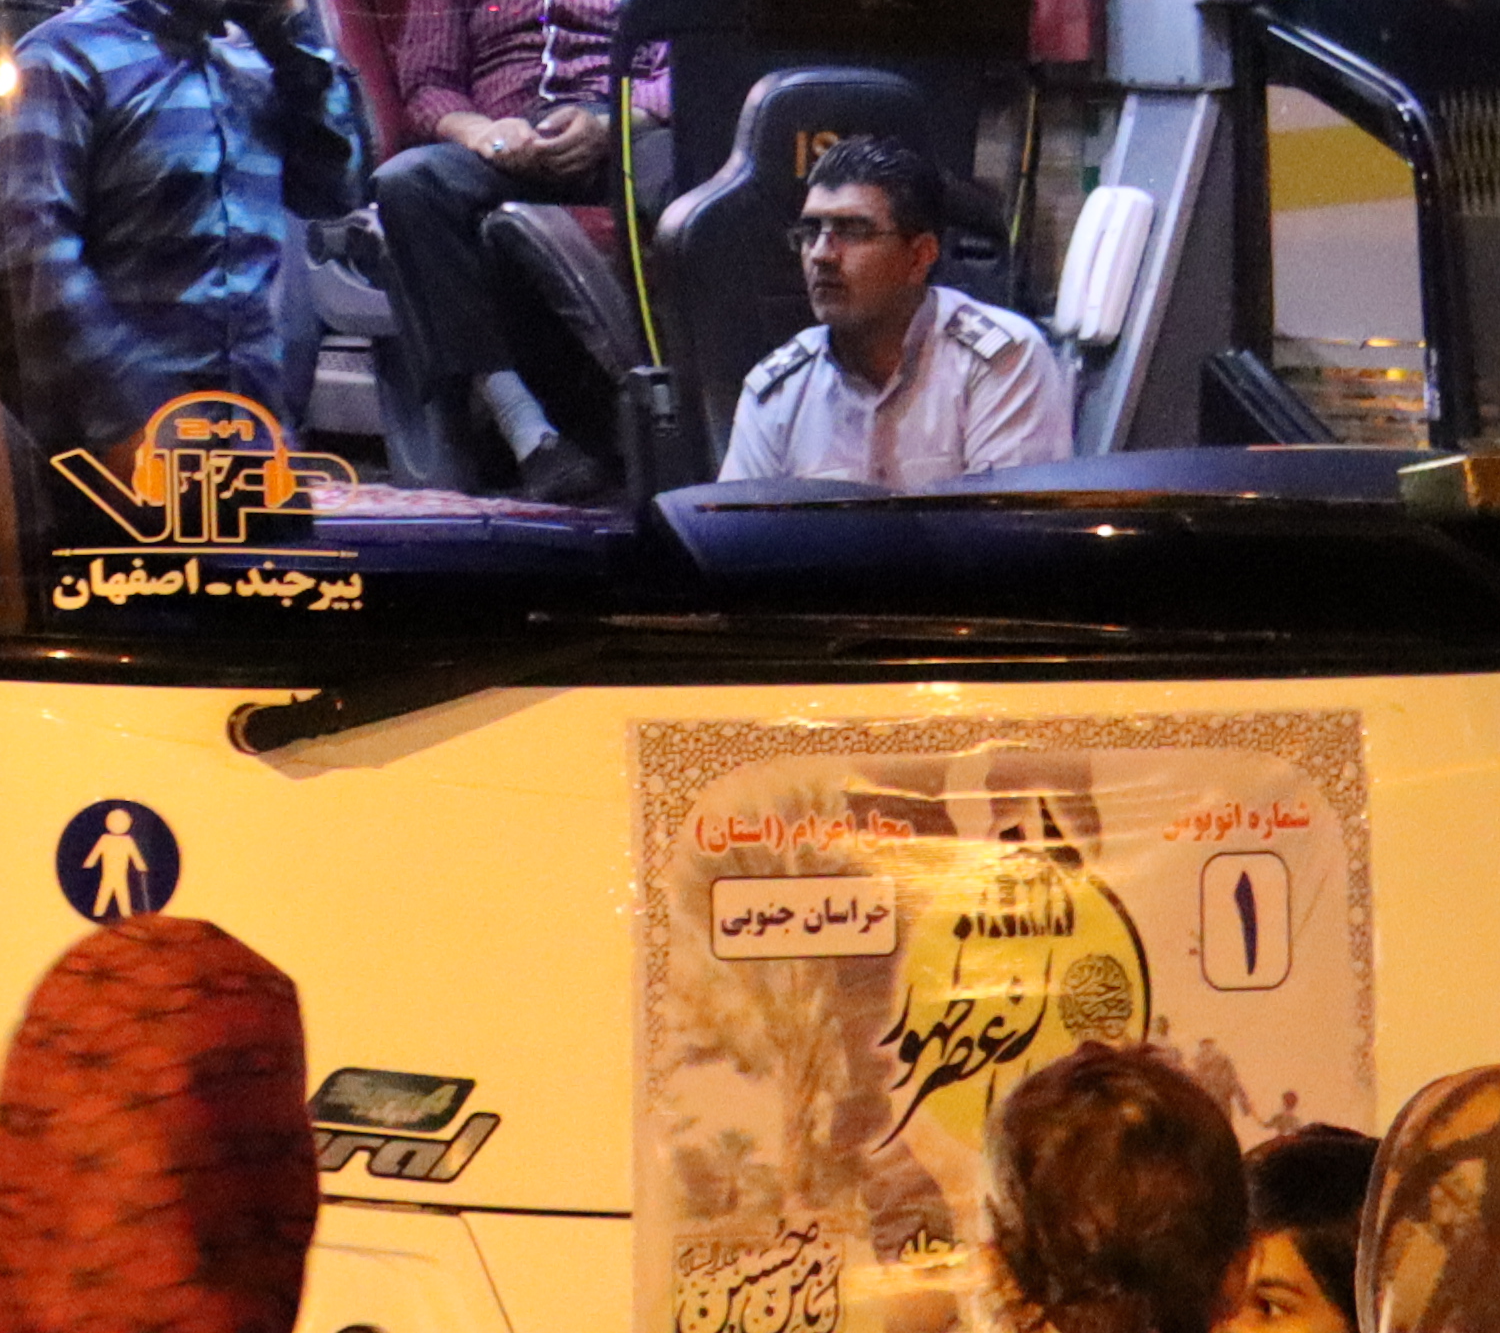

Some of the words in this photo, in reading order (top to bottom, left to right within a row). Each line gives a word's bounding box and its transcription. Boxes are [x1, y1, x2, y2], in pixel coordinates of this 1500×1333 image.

[50, 447, 359, 544] VIP
[52, 557, 199, 611] اصفهان
[235, 559, 363, 611] بیرجند
[791, 810, 857, 851] اعزام
[1162, 801, 1243, 841] اتوبوس
[1248, 802, 1311, 840] شماره
[721, 900, 795, 937] جنوبی
[803, 896, 891, 935] خراسان
[311, 1111, 502, 1184] ral
